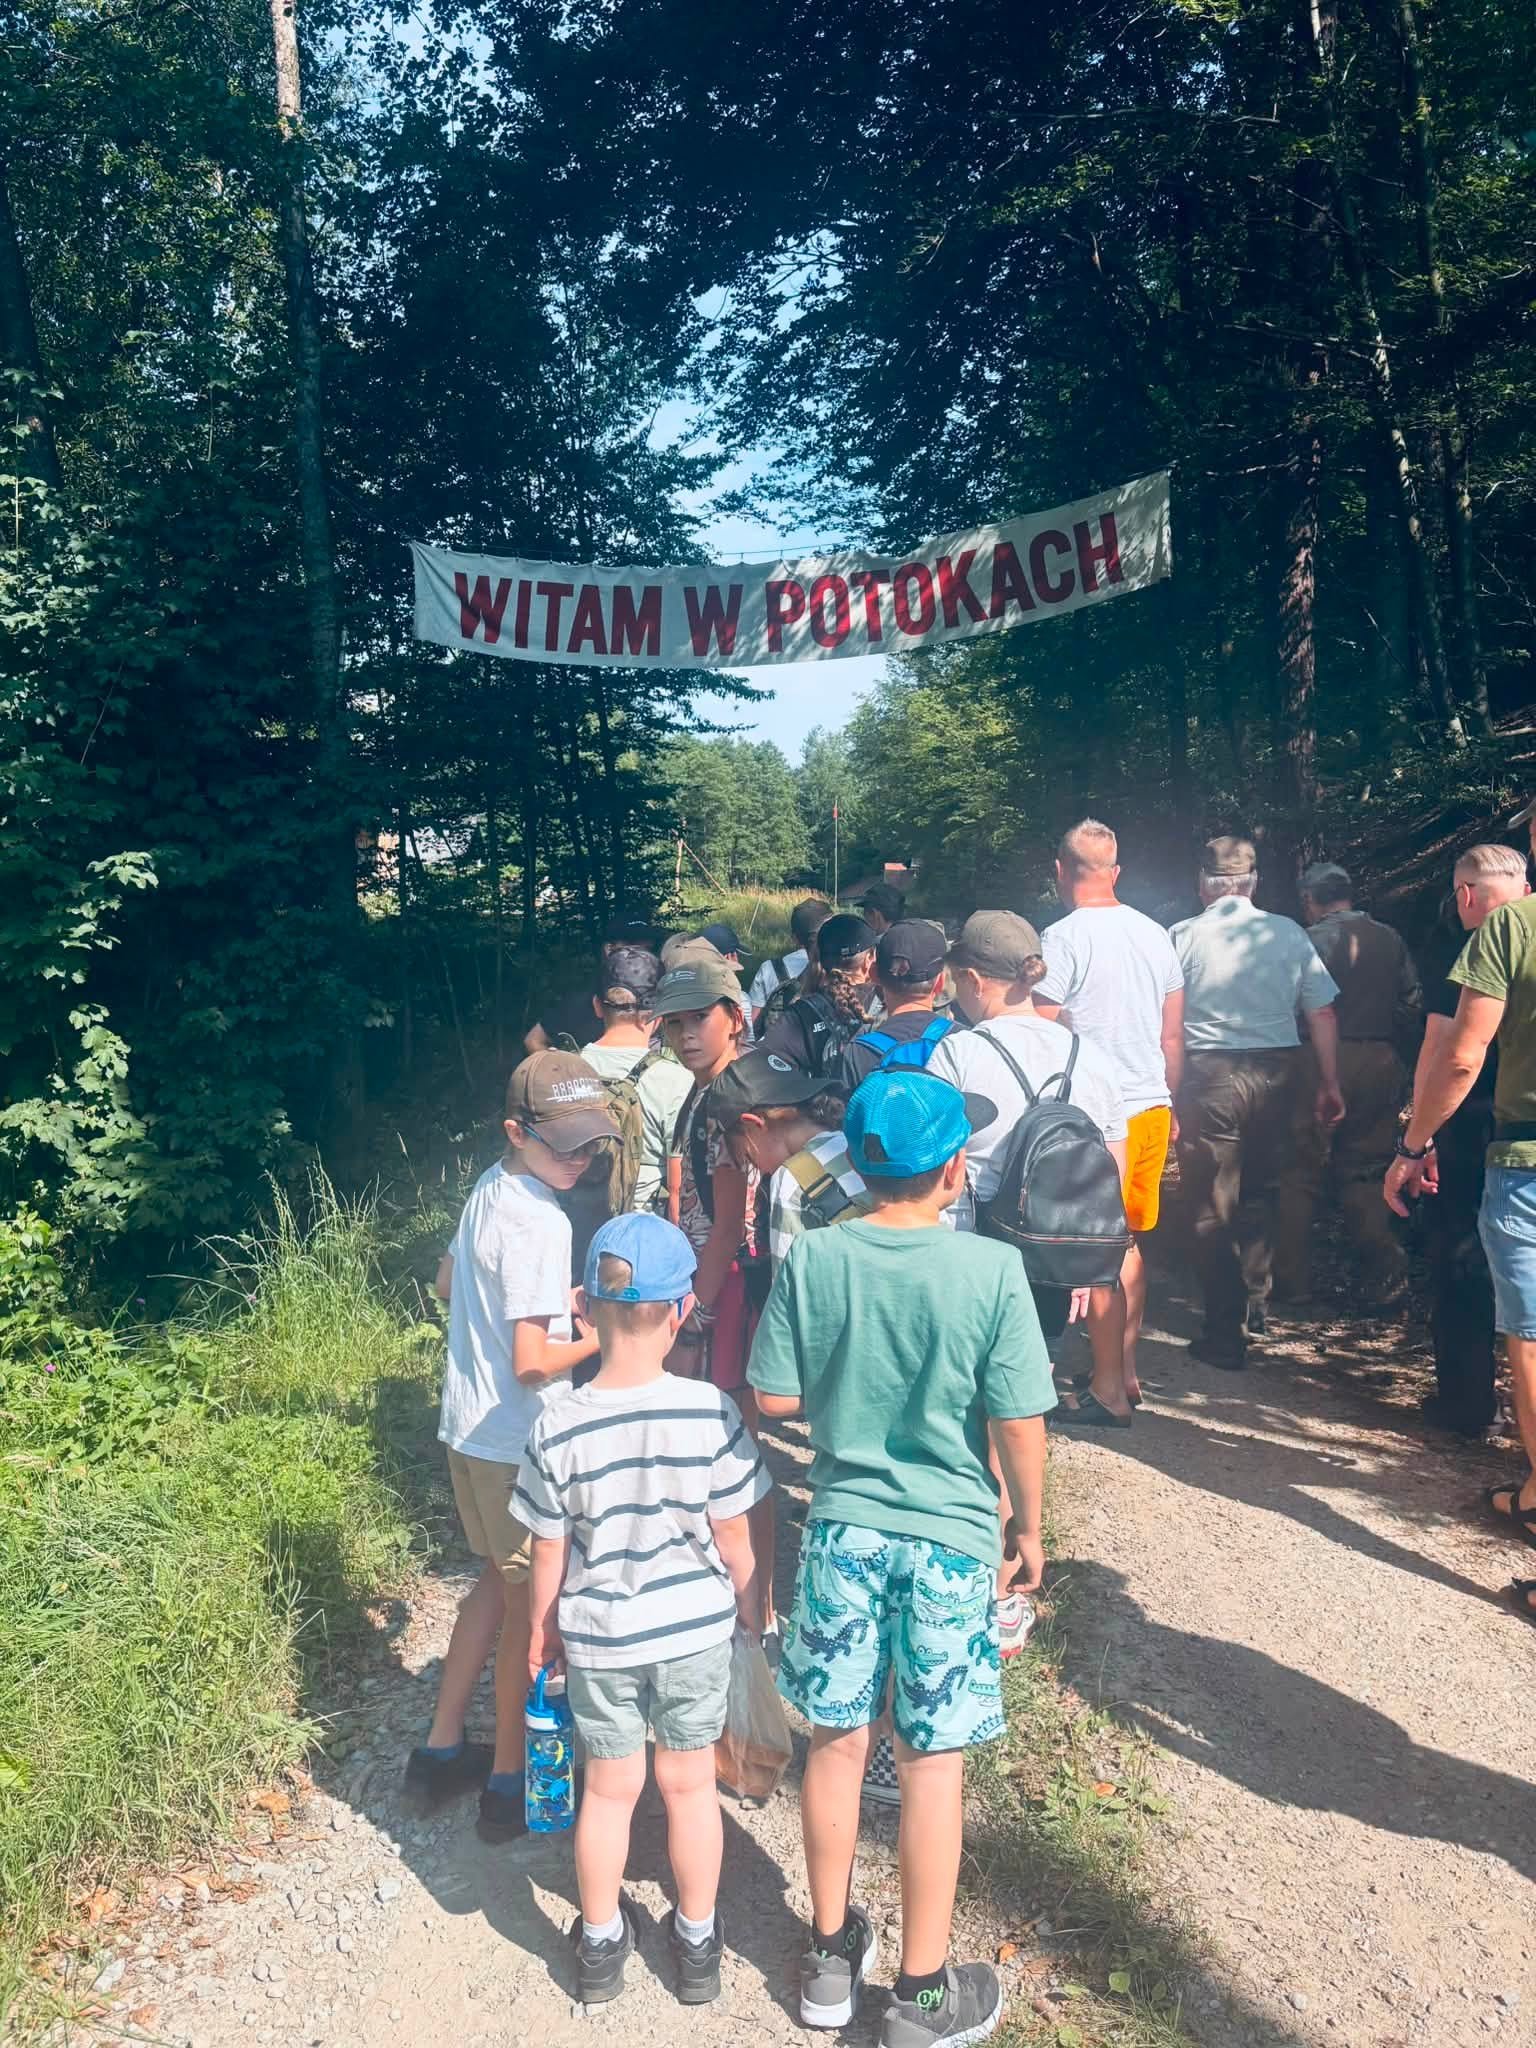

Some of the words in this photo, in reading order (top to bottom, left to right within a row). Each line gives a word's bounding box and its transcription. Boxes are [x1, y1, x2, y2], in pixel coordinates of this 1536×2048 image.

[454, 572, 662, 656] WITAM
[683, 584, 744, 657] W
[765, 511, 1124, 652] POTOKACH
